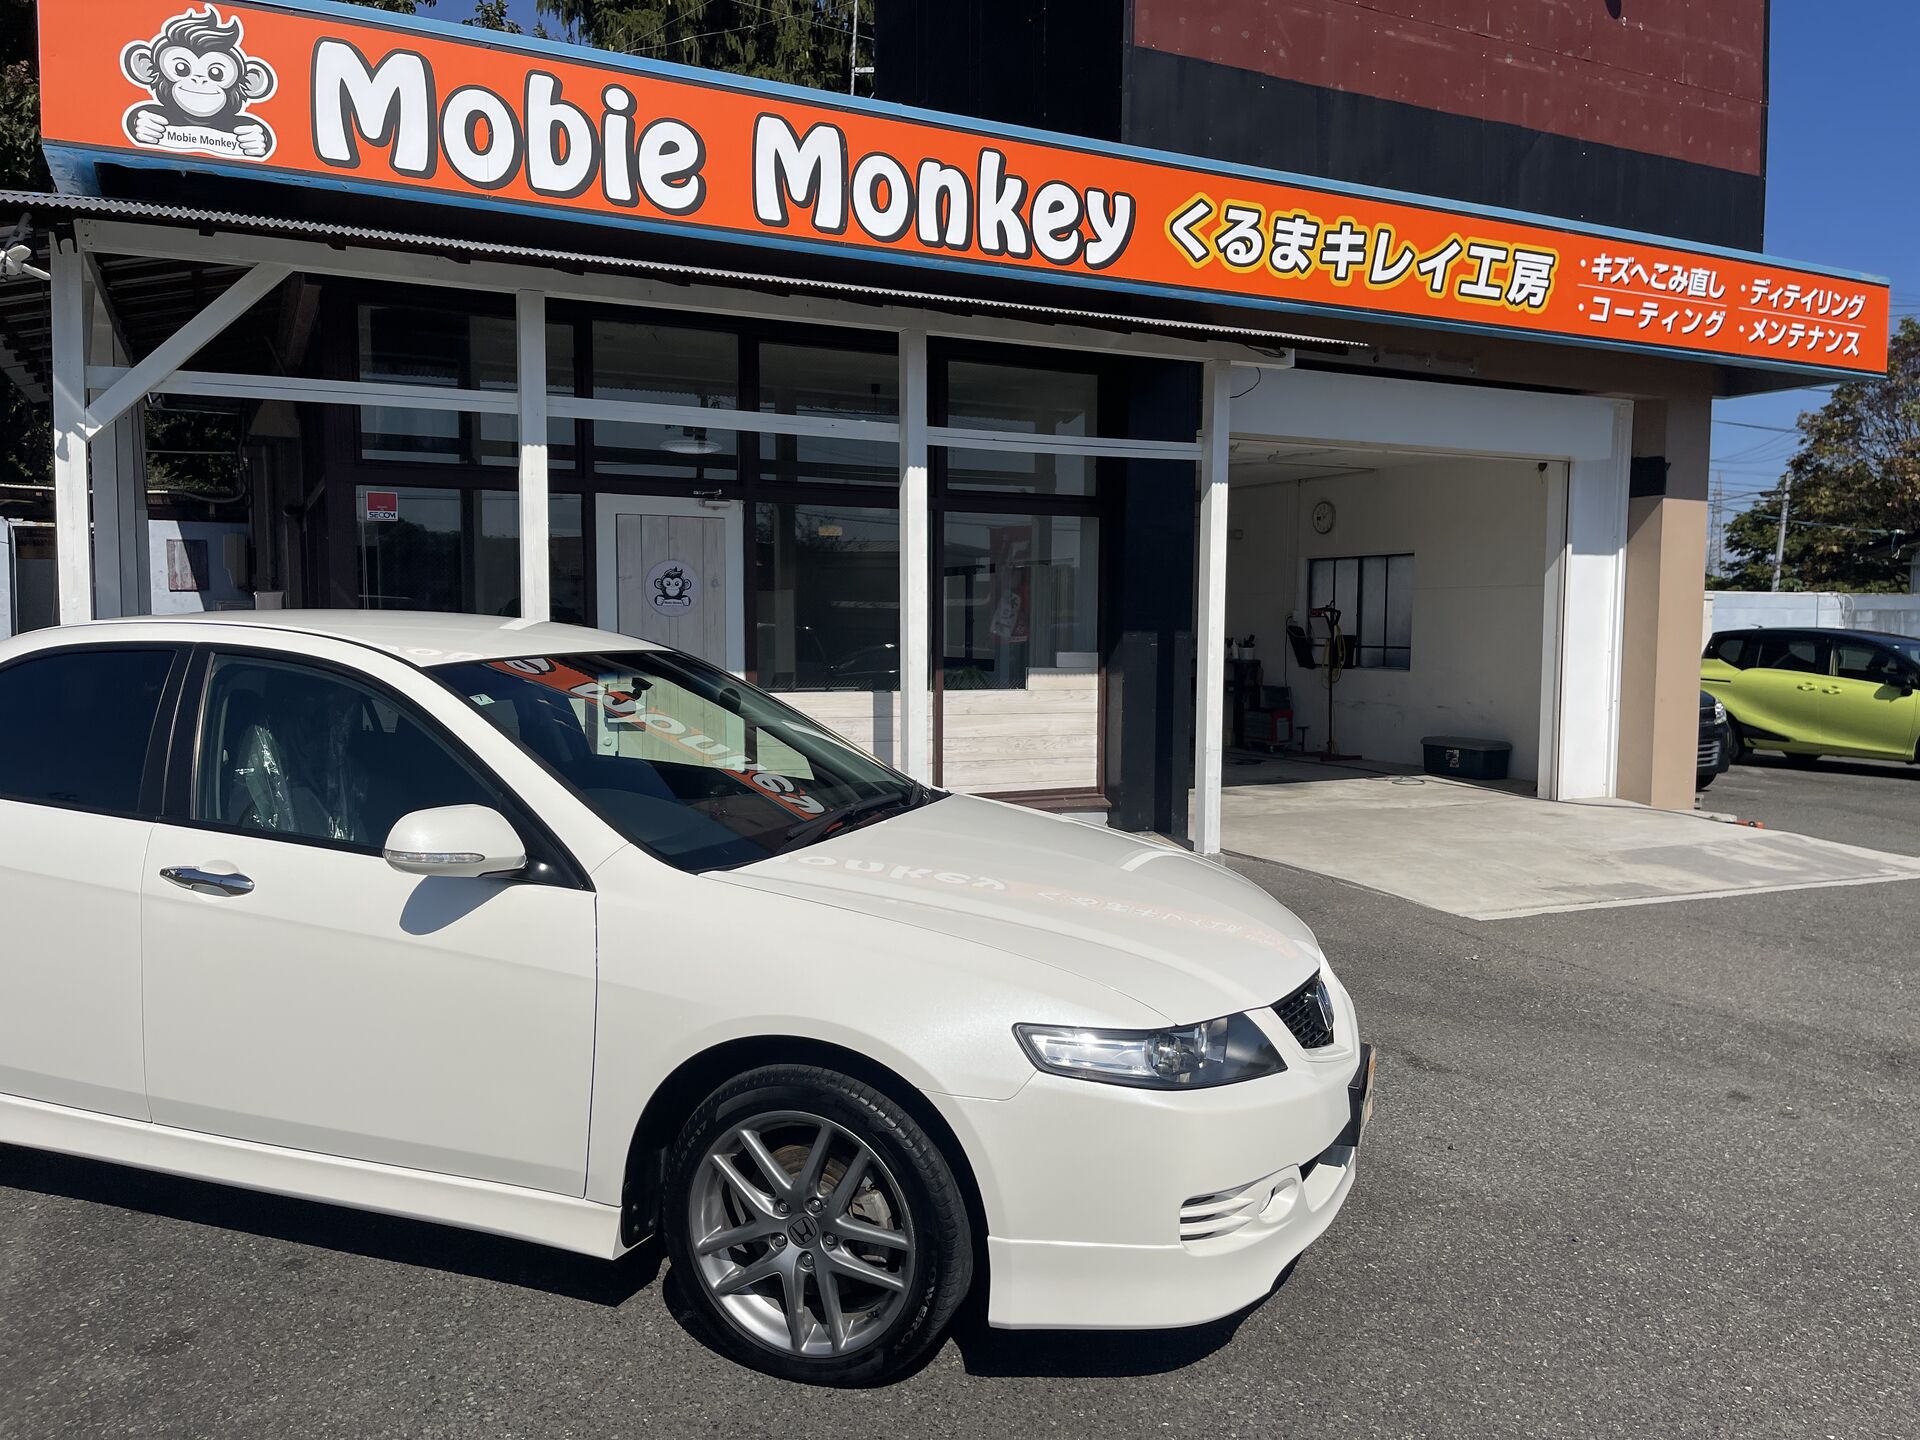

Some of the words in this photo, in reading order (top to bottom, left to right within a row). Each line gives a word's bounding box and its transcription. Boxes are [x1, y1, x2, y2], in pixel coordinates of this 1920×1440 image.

[167, 131, 197, 144] Mobie
[200, 135, 237, 151] Monkey
[311, 36, 706, 215] Mobie
[752, 112, 1136, 270] Monkey
[1168, 196, 1557, 310] くるまキレイ工房
[368, 511, 397, 519] SECOM
